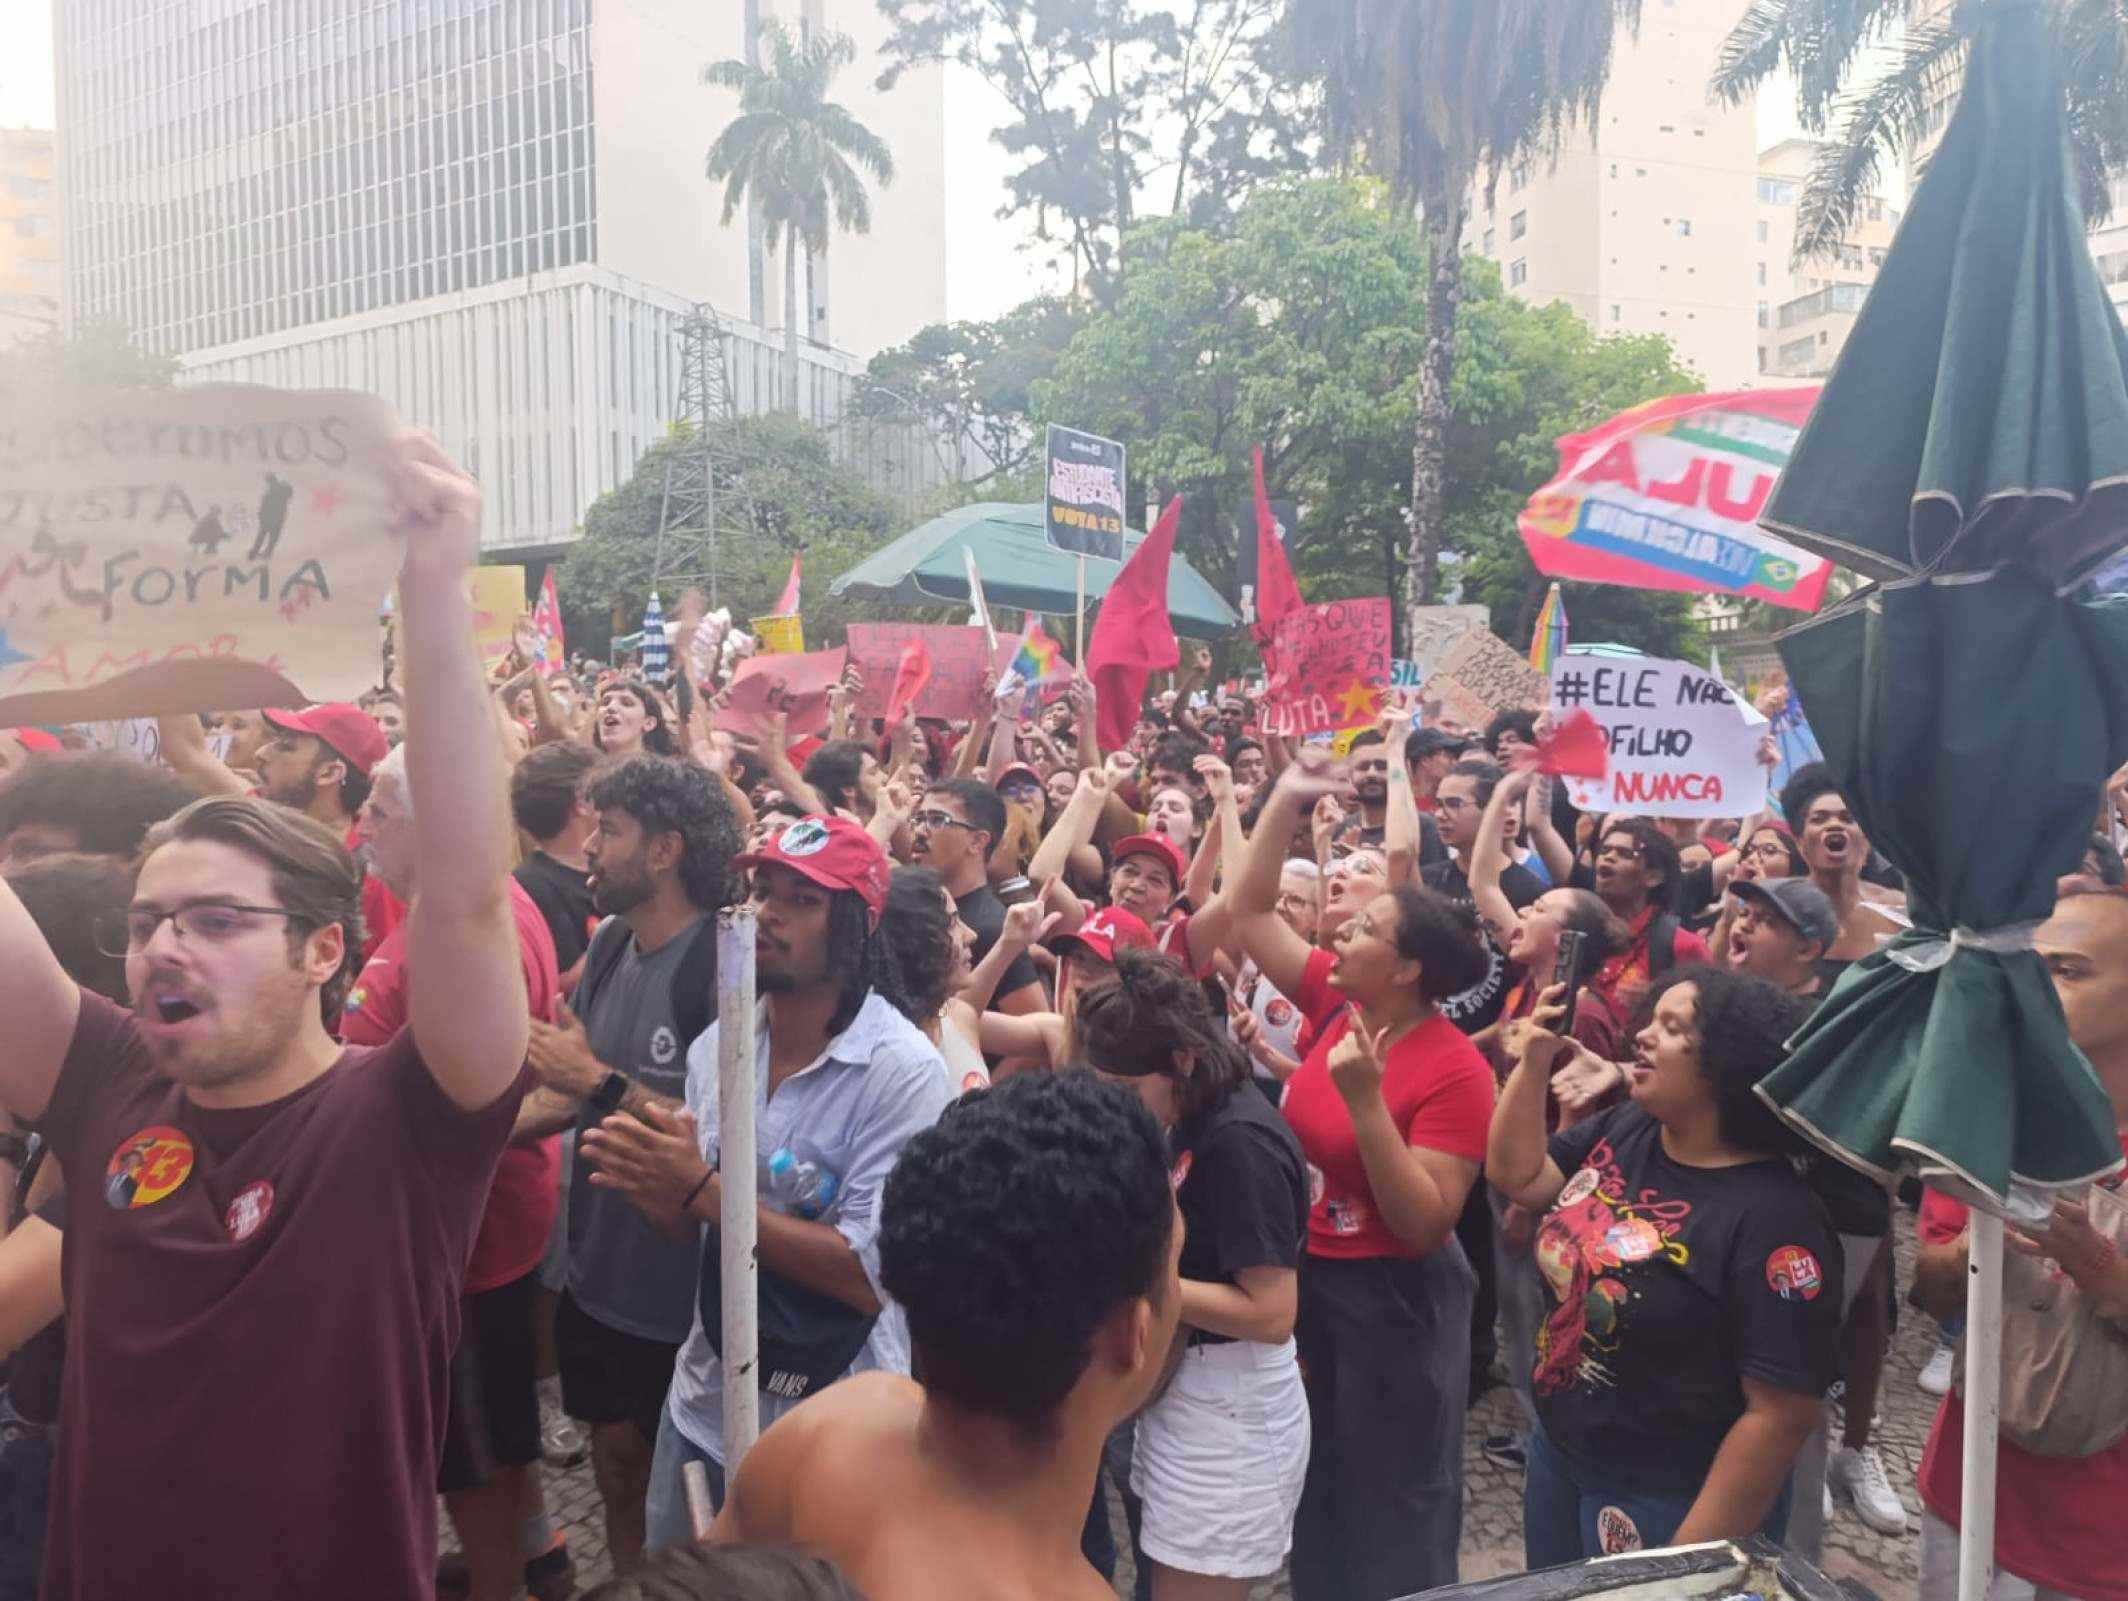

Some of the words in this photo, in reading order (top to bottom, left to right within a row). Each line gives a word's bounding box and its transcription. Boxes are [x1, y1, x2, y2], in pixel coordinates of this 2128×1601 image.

[1052, 506, 1096, 531] VOTA
[1098, 517, 1121, 534] 13
[1391, 659, 1421, 685] SIL
[1555, 667, 1660, 707] #ELE
[1261, 693, 1331, 737] LUTA
[1613, 770, 1722, 803] NUNCA
[767, 1370, 809, 1398] VANS
